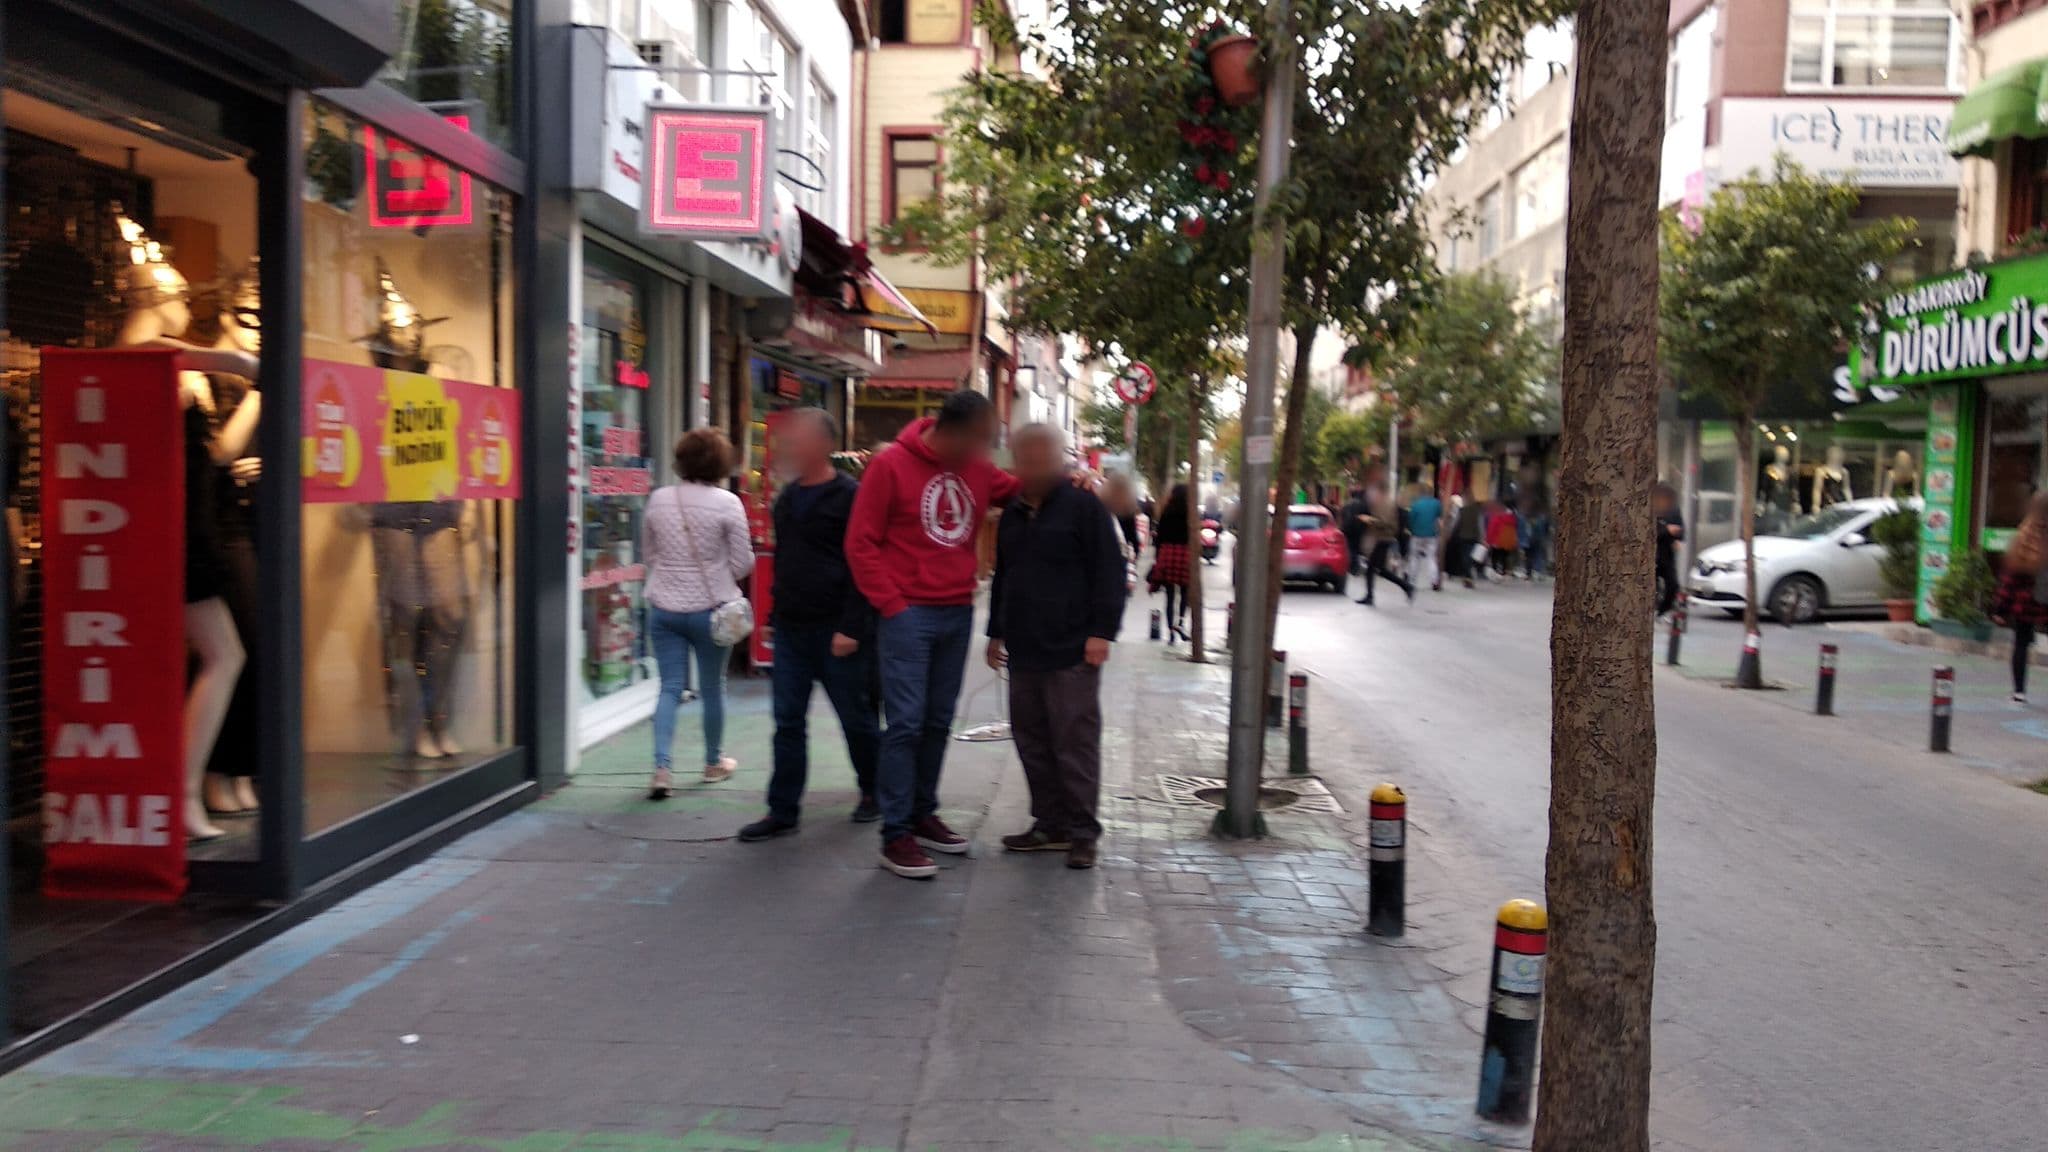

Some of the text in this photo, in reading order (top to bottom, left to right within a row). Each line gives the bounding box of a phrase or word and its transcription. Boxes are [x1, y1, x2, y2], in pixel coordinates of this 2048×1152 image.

[1772, 113, 1827, 143] ICE
[1906, 268, 1988, 315] BAKIRKÖY
[393, 400, 449, 434] BÜYÜK
[42, 792, 171, 846] SALE
